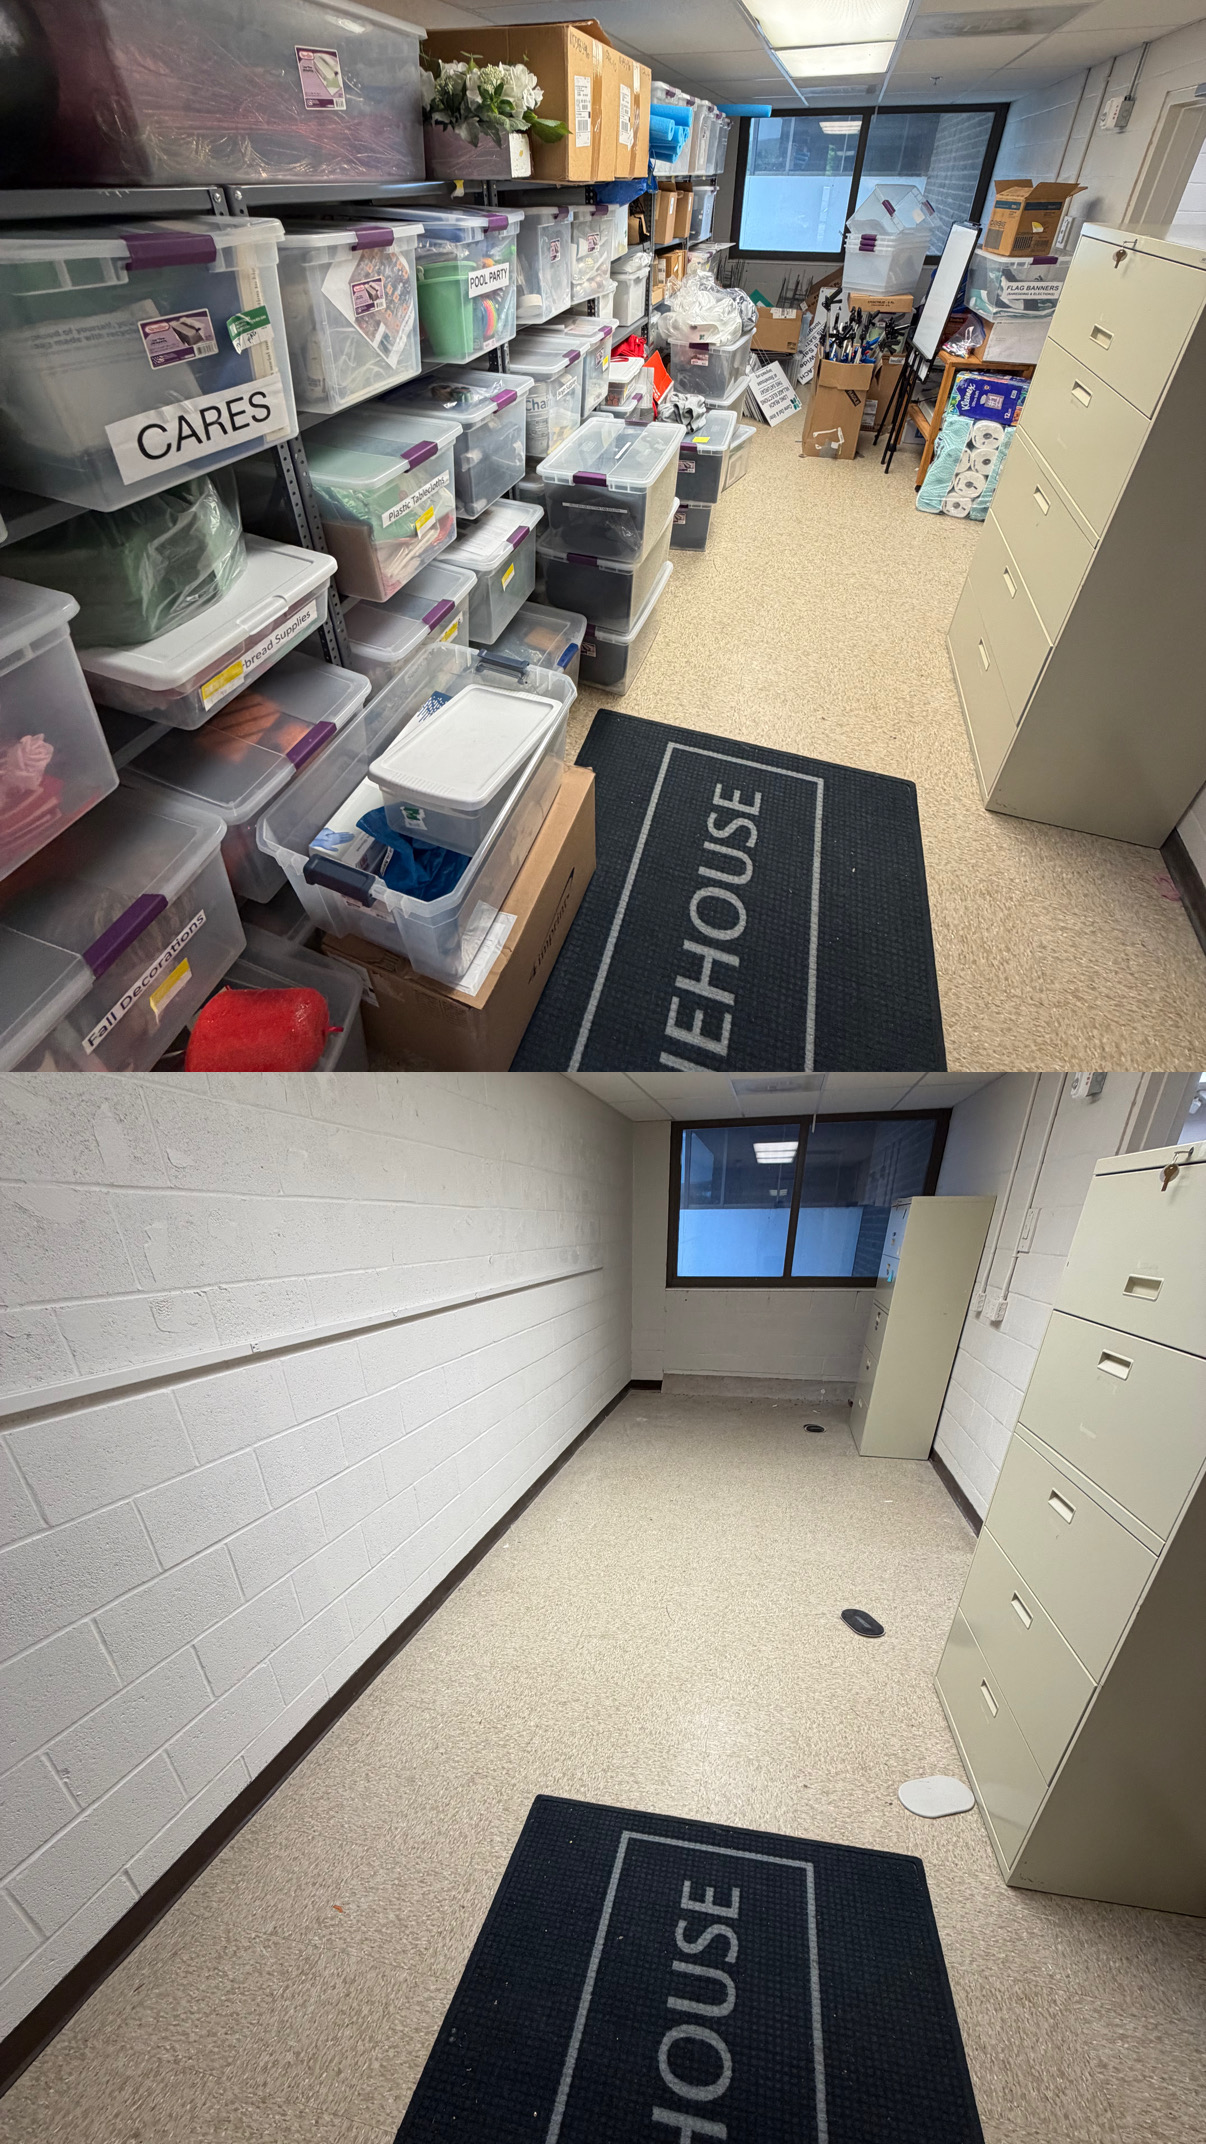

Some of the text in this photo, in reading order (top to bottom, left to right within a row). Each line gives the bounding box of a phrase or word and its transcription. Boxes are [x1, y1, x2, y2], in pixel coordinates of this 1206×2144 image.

[469, 267, 508, 290] POOL PARTY
[760, 384, 776, 395] SATURDAY
[760, 386, 790, 406] VILLAGE ELECTIONS
[769, 394, 789, 409] LONG REACH
[961, 383, 976, 411] Kleenex
[137, 391, 271, 460] CARES
[388, 476, 445, 522] Plastic Tablecloths
[242, 610, 311, 669] bread Supplies
[87, 914, 205, 1047] Fall Decorations
